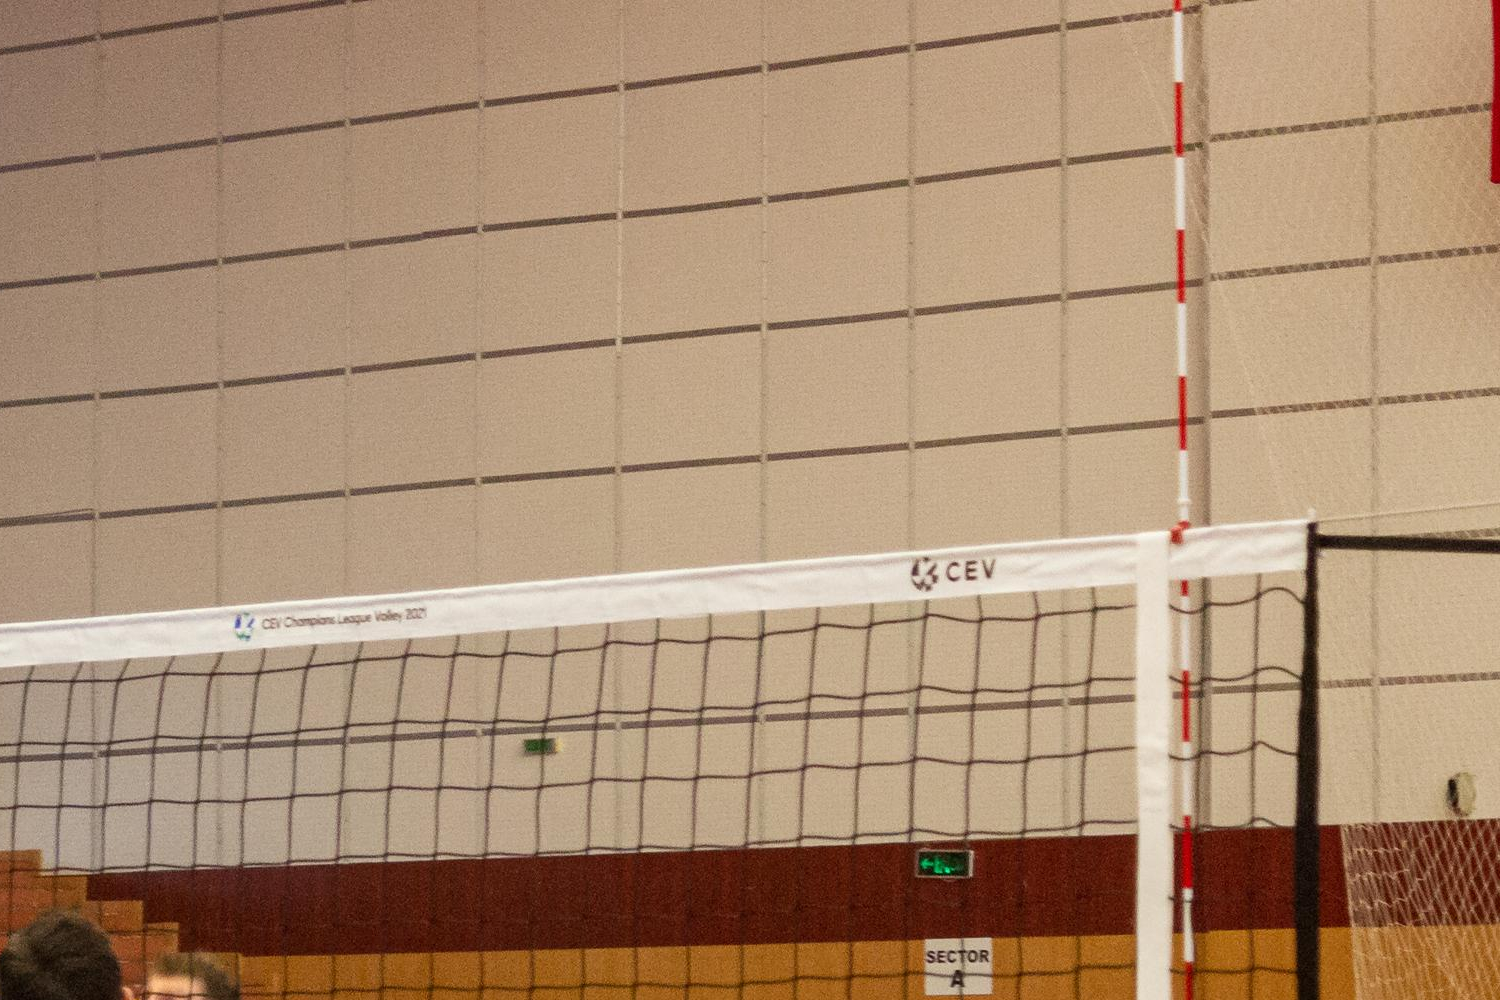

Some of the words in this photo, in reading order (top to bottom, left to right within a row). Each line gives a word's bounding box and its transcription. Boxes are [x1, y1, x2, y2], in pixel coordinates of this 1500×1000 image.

[946, 559, 997, 581] CEV
[284, 615, 336, 629] Champions
[337, 612, 372, 626] League
[375, 609, 402, 624] Volley
[926, 949, 990, 964] SECTOR
[950, 970, 965, 988] A
